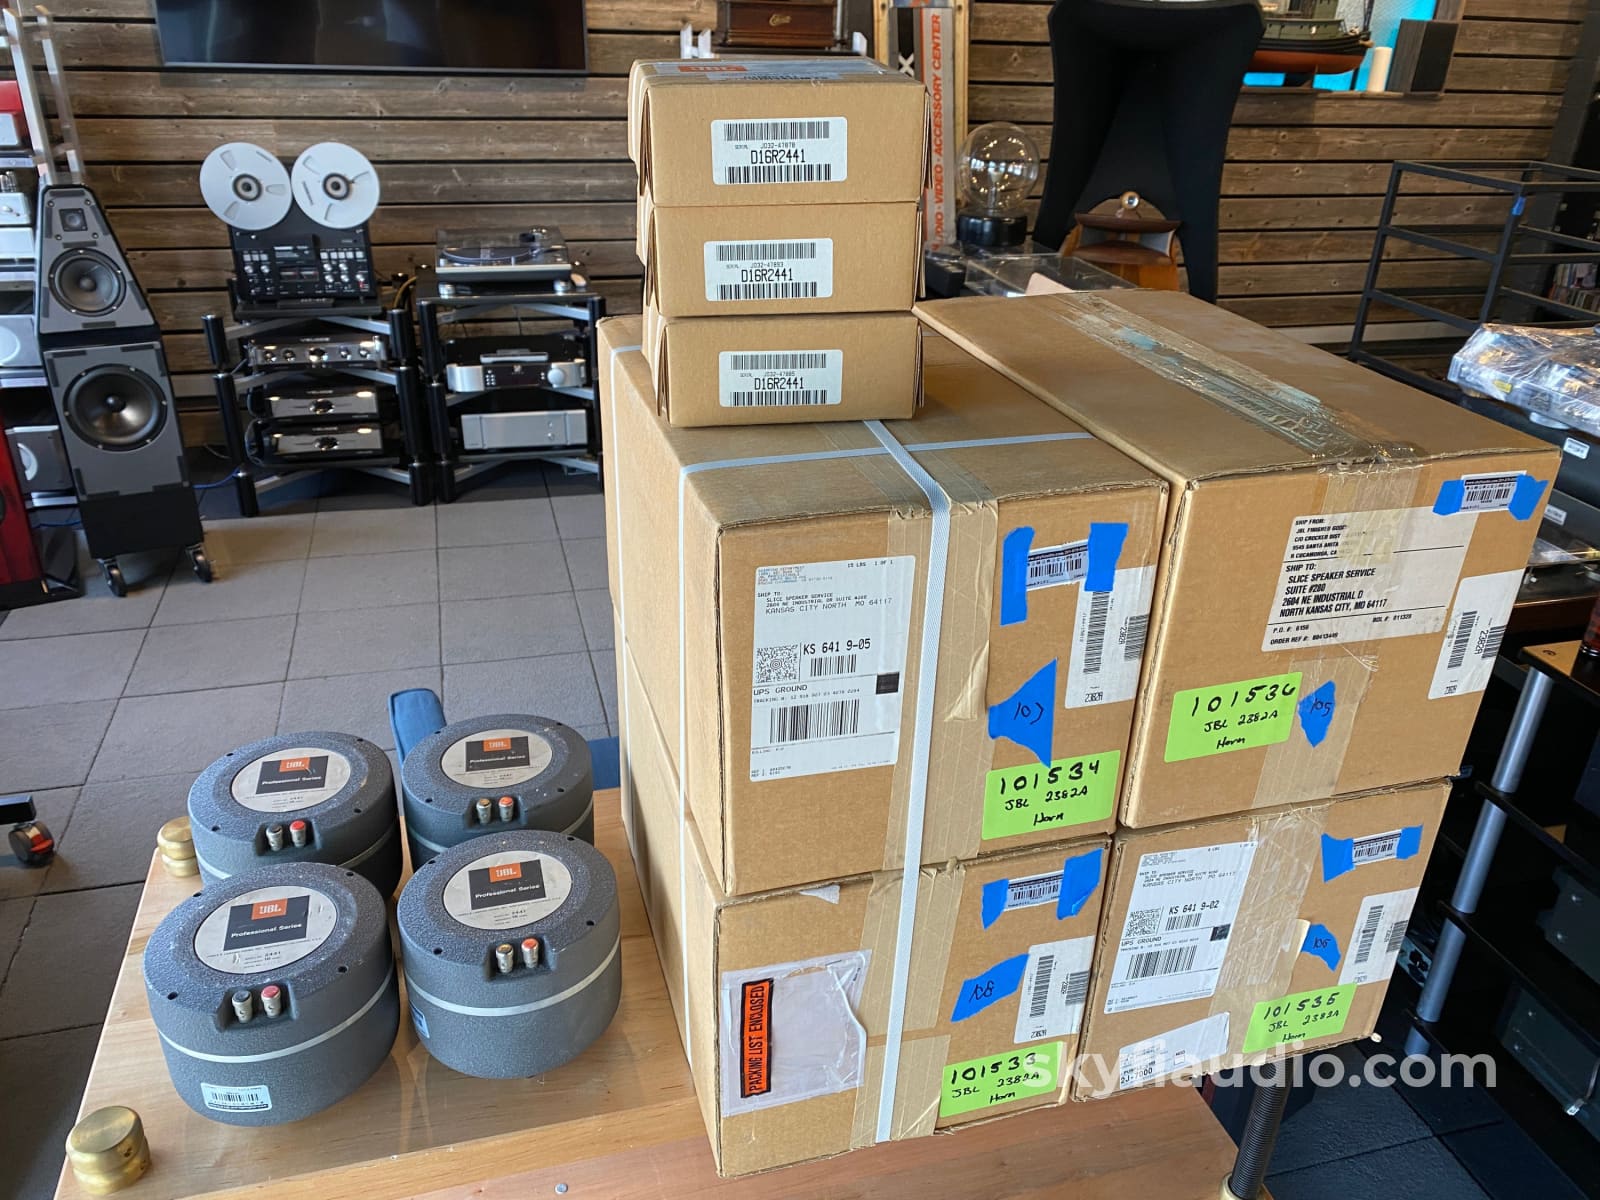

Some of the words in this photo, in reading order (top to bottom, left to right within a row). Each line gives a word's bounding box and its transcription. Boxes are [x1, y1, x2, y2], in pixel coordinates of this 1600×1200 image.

[931, 14, 942, 70] CENTER
[932, 74, 943, 157] ACCESSORY
[750, 148, 806, 165] D16R2441
[933, 164, 944, 204] VIDEO
[741, 267, 793, 283] D16R2441
[754, 377, 804, 390] D16R2441
[1305, 542, 1323, 550] SANTA
[1285, 564, 1304, 573] SHIP
[1305, 563, 1317, 571] TO:
[1288, 574, 1309, 584] SLICE
[1311, 570, 1344, 581] SPEAKER
[1345, 567, 1376, 578] SERVICE
[1285, 586, 1307, 596] SUITE
[1301, 595, 1312, 605] NE
[1313, 591, 1356, 603] INDUSTRIAL
[765, 606, 795, 615] KANSAS
[799, 604, 819, 612] CITY
[822, 602, 847, 610] NORTH
[869, 597, 893, 606] 64117
[1279, 607, 1304, 618] NORTH
[1305, 604, 1333, 615] KANSAS
[1334, 602, 1352, 614] CITY,
[1353, 600, 1366, 610] MO
[1366, 598, 1388, 609] 64117
[1118, 626, 1128, 645] 2382A
[1270, 637, 1290, 645] ORDER
[1291, 635, 1302, 643] REF
[1474, 629, 1489, 655] 2382A
[803, 644, 816, 655] KS
[822, 641, 840, 653] 641
[846, 638, 871, 651] 9-05
[753, 687, 770, 696] UPS
[775, 684, 808, 694] GROUND
[1191, 683, 1297, 717] 101536
[1203, 719, 1228, 732] JBL
[1237, 710, 1278, 726] 2382A
[1000, 760, 1100, 795] 101534
[1005, 798, 1030, 811] JBL
[1045, 785, 1088, 803] 2382A
[475, 887, 517, 899] Professional
[259, 903, 282, 914] JBL
[1168, 905, 1180, 915] KS
[1182, 903, 1197, 913] 641
[231, 926, 277, 938] Professional
[278, 923, 302, 931] Series
[1121, 939, 1135, 947] UPS
[1137, 936, 1162, 945] GROUND
[749, 985, 765, 1032] ENCLOSED
[1263, 991, 1340, 1020] 101535
[1268, 1020, 1289, 1032] JBL
[748, 1035, 763, 1055] LIST
[748, 1055, 763, 1092] PACKING
[951, 1052, 1037, 1085] 101533
[951, 1086, 981, 1099] JBL
[997, 1072, 1040, 1088] 2382A
